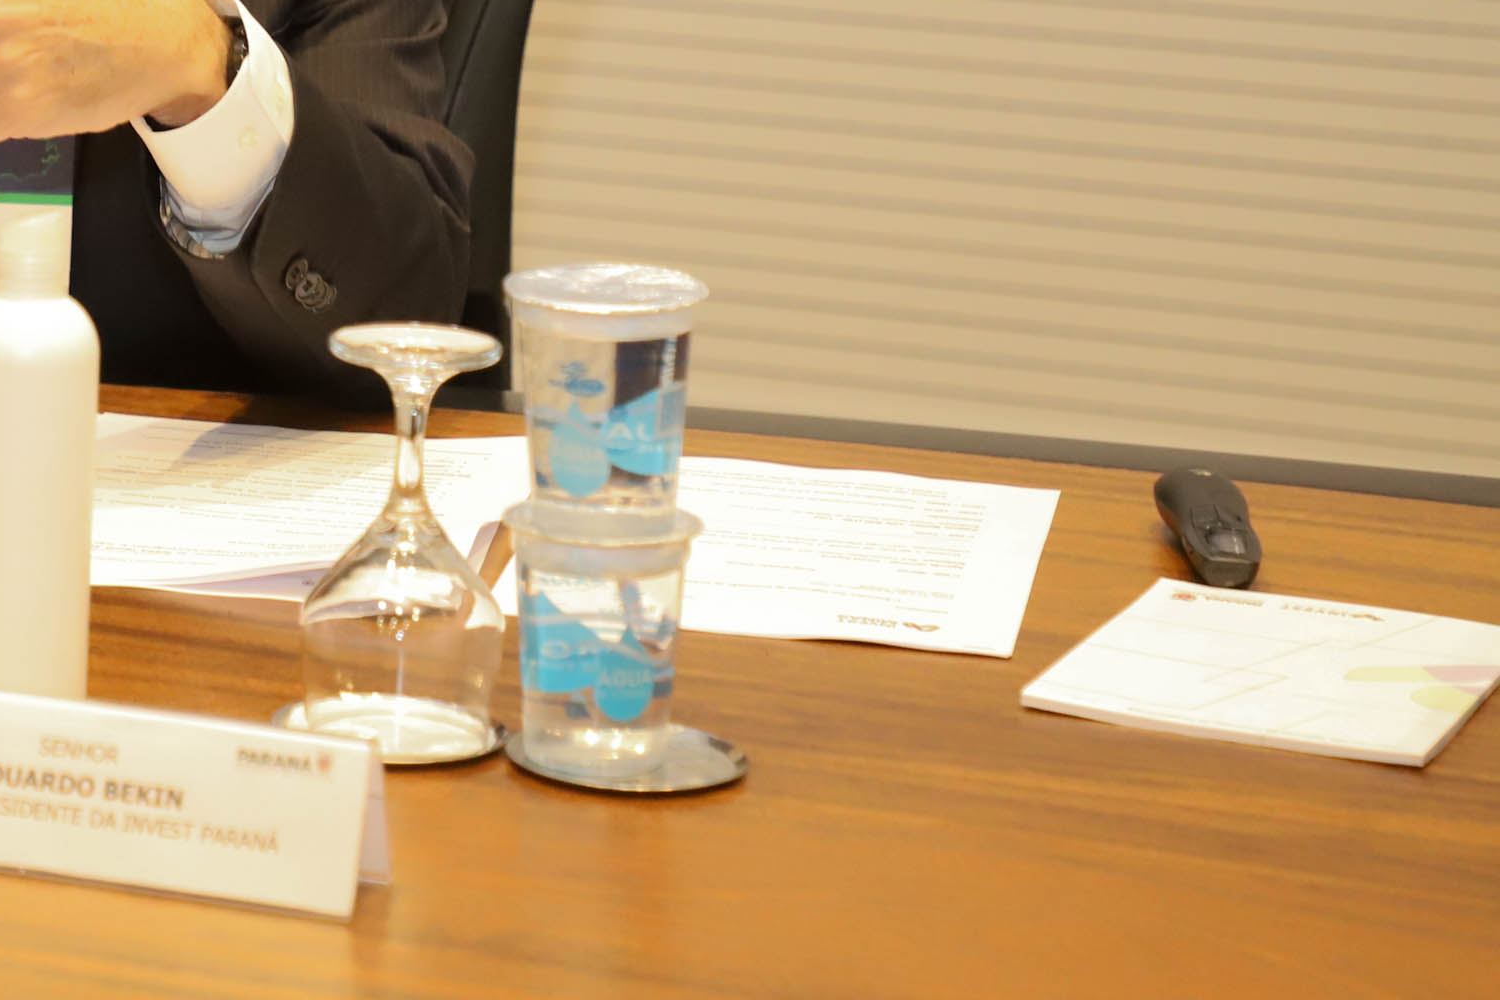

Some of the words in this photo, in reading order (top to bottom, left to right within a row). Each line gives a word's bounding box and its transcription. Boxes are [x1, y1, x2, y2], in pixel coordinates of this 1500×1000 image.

[38, 735, 119, 765] SENHOR
[103, 780, 185, 811] BEKIN
[89, 809, 117, 831] DA
[123, 813, 195, 842] INVEST
